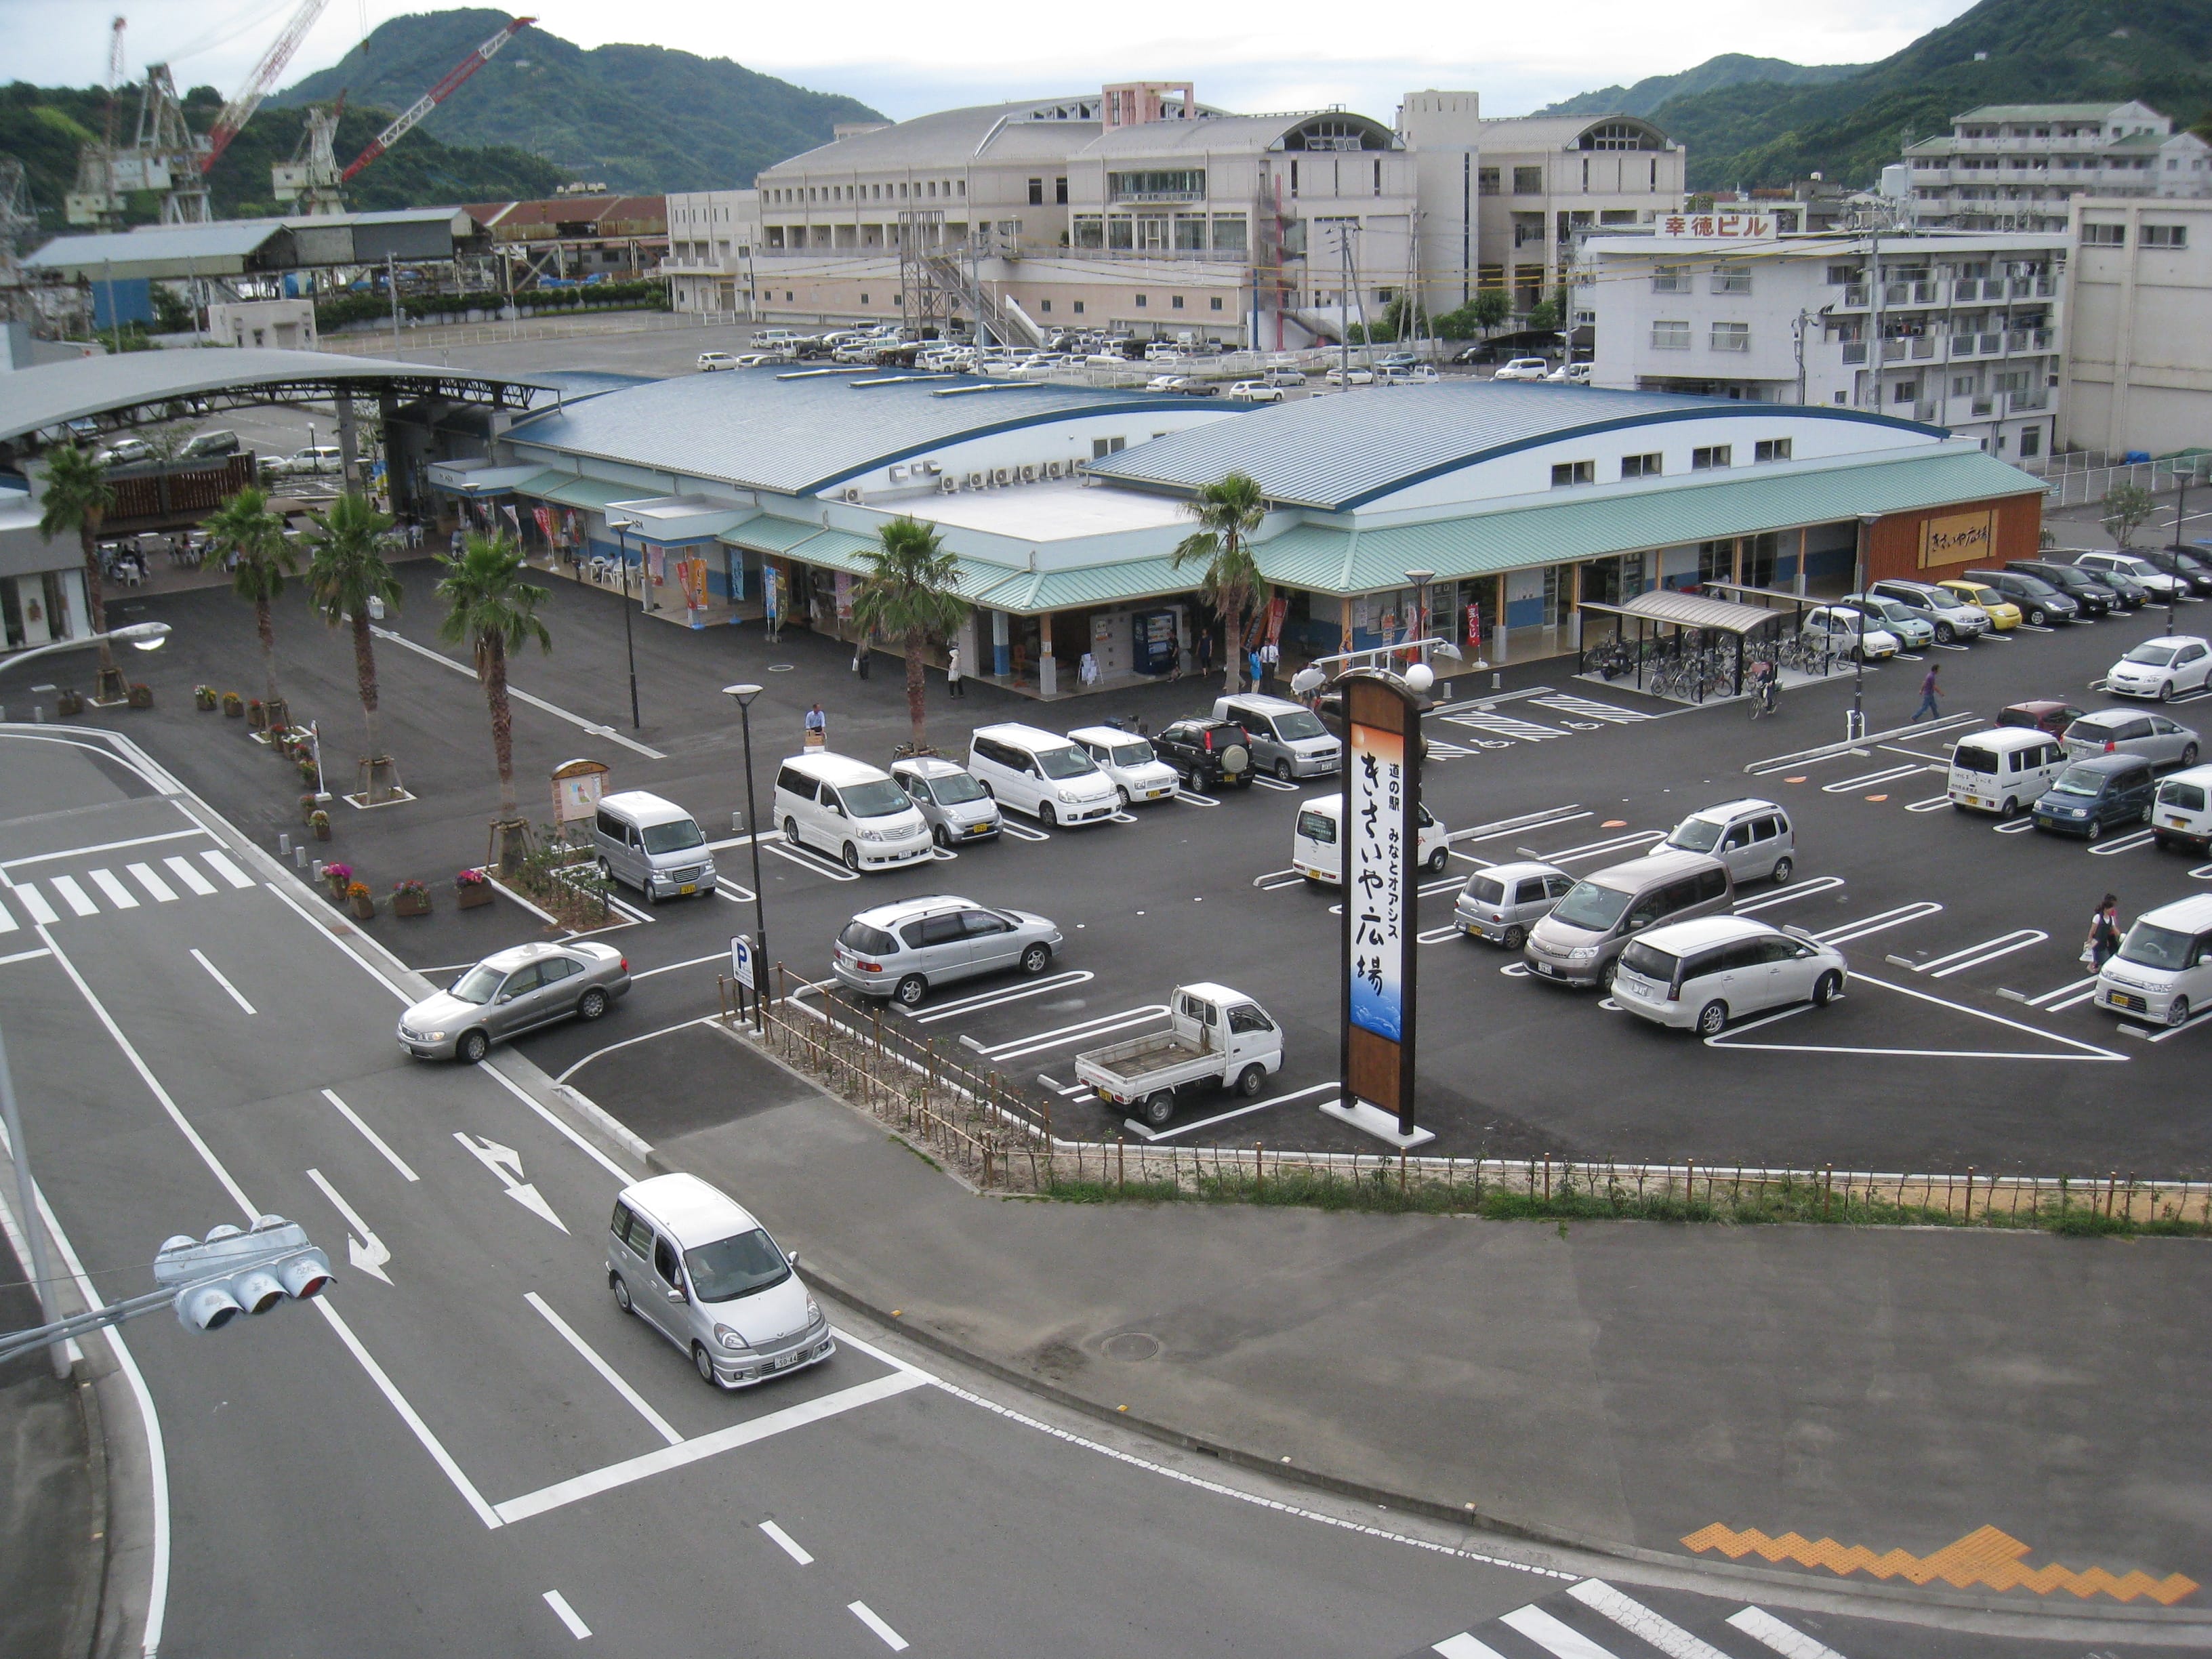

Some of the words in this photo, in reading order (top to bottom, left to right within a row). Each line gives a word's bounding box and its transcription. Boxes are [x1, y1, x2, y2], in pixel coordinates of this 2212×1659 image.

[1664, 215, 1768, 237] 幸徳ビル
[1389, 763, 1400, 812] 道の駅
[1357, 751, 1385, 997] きさいや広場
[1387, 827, 1399, 939] みなとオアシス
[737, 942, 747, 970] P
